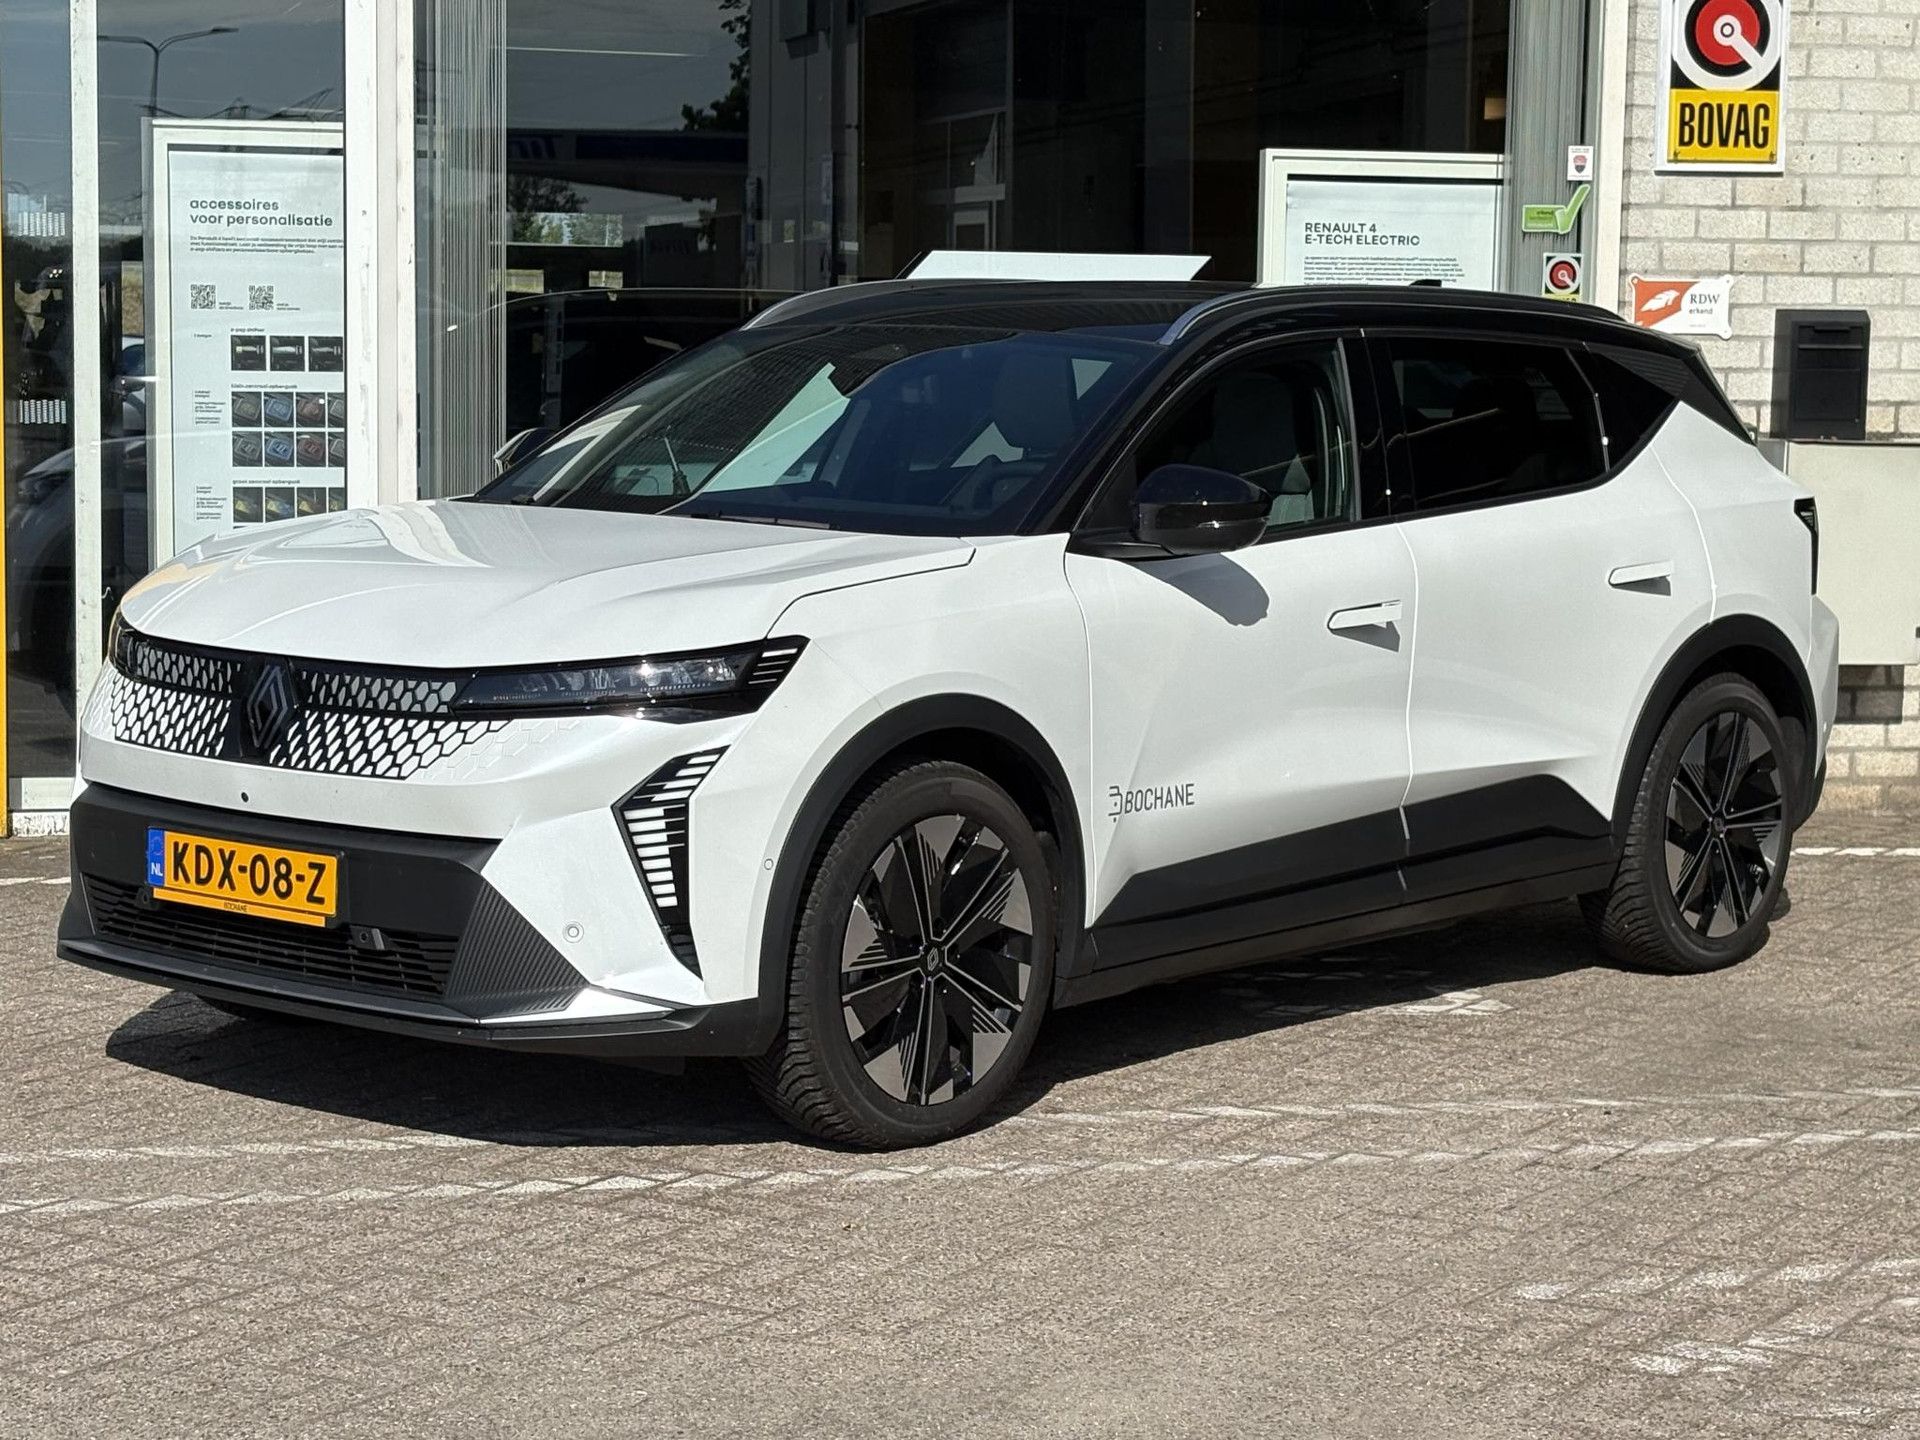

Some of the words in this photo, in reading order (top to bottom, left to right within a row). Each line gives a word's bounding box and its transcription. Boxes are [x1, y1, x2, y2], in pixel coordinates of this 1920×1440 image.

[1678, 102, 1770, 149] BOVAG
[190, 199, 279, 211] accessoires
[190, 214, 223, 224] voor
[227, 214, 333, 227] personalisatie
[1305, 222, 1367, 234] RENAULT
[1369, 223, 1377, 234] 4
[1305, 234, 1353, 245] E-TECH
[1356, 235, 1420, 246] ELECTRIC
[1690, 293, 1720, 304] RDW
[1124, 783, 1195, 815] BOCHANE
[151, 862, 163, 877] NL
[173, 841, 326, 905] KDX-08-Z
